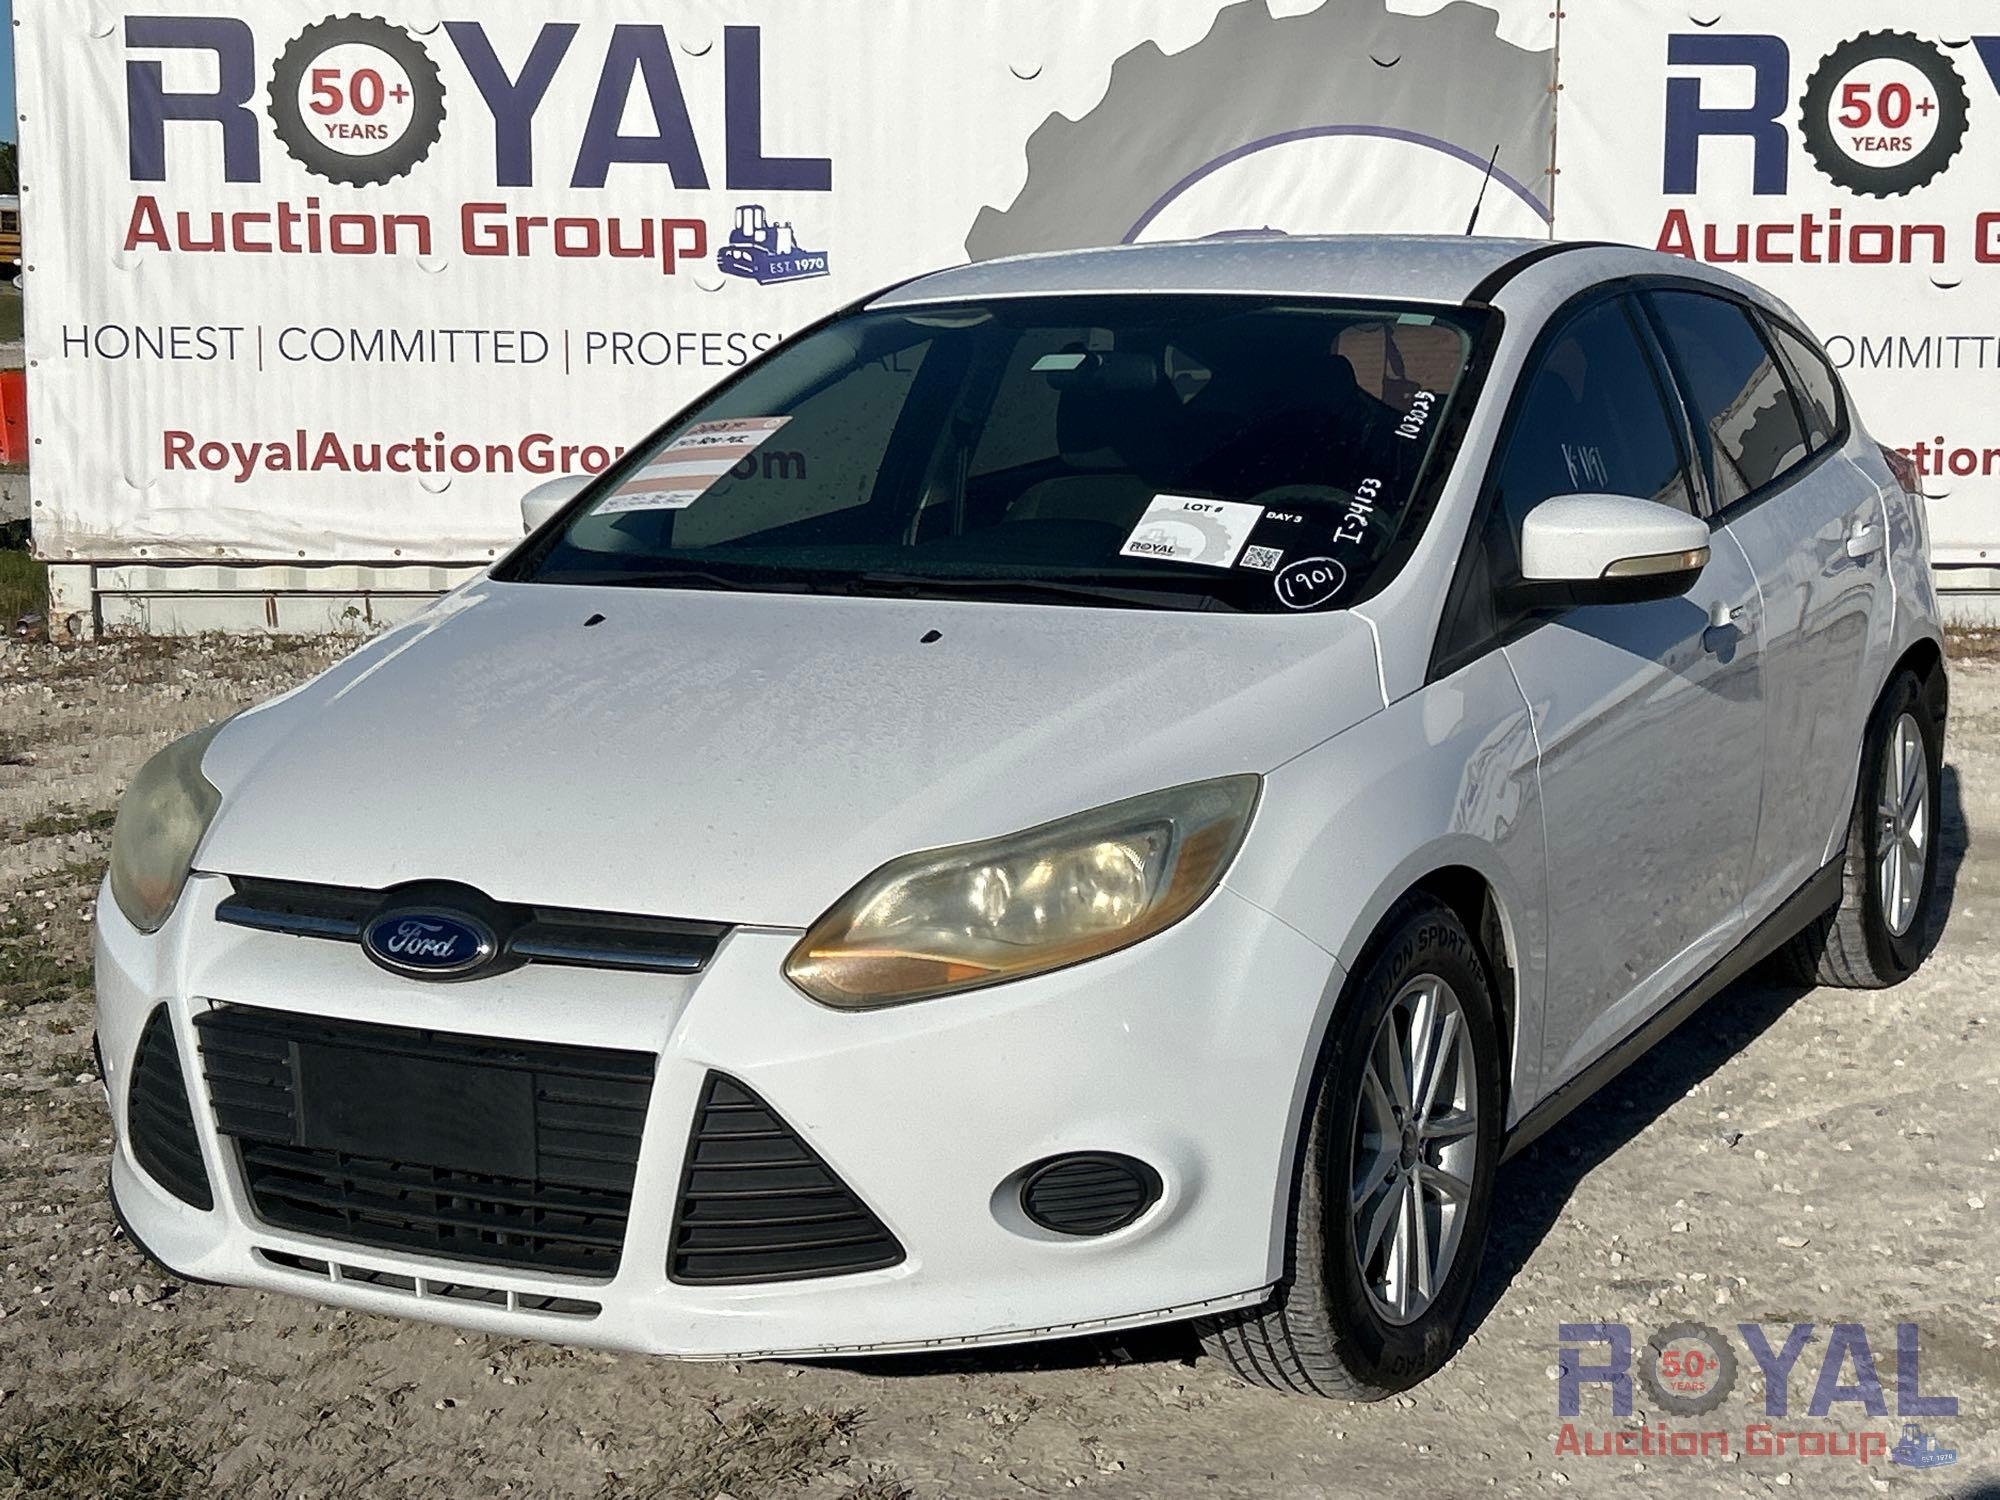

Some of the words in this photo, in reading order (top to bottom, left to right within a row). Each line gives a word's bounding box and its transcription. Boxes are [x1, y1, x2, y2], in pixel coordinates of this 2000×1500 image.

[124, 12, 832, 192] ROYAL
[309, 68, 410, 117] 50+
[1838, 82, 1936, 129] 50+
[325, 122, 389, 140] YEARS
[1851, 136, 1913, 152] YEARS
[123, 195, 432, 256] Auction
[460, 202, 707, 275] Group
[1655, 208, 1946, 264] Auction
[794, 257, 826, 272] 1970
[61, 324, 244, 362] HONEST
[278, 327, 550, 365] COMMITTED
[1394, 389, 1437, 441] 103025
[1183, 502, 1212, 513] LOT
[1265, 511, 1293, 523] DAY
[1129, 541, 1176, 554] ROYAL
[1284, 566, 1335, 598] 1901
[387, 920, 459, 958] Ford
